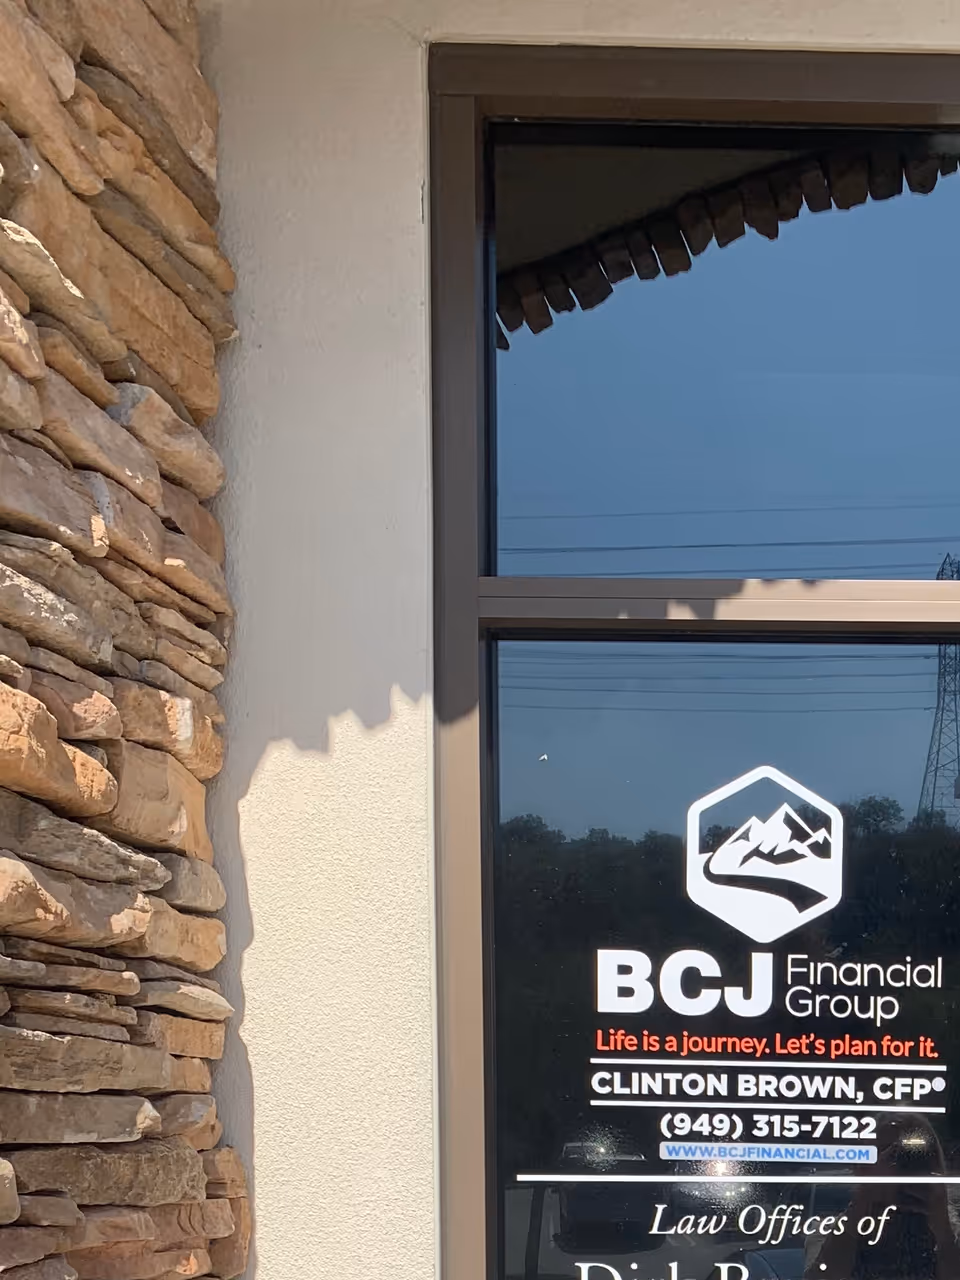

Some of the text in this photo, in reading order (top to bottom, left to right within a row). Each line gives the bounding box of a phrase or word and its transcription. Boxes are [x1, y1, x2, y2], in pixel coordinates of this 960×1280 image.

[596, 948, 774, 1018] BCJ
[785, 953, 943, 989] Financial
[785, 988, 899, 1026] Group
[595, 1028, 940, 1060] Life is a journey. Let's plan for it.
[590, 1071, 728, 1096] CLINTON
[737, 1074, 866, 1104] BROWN,
[660, 1112, 878, 1140] (949) 315-7122
[664, 1143, 870, 1162] WWW.BCJFINANCIAL.COM
[648, 1203, 897, 1245] Law Offices of
